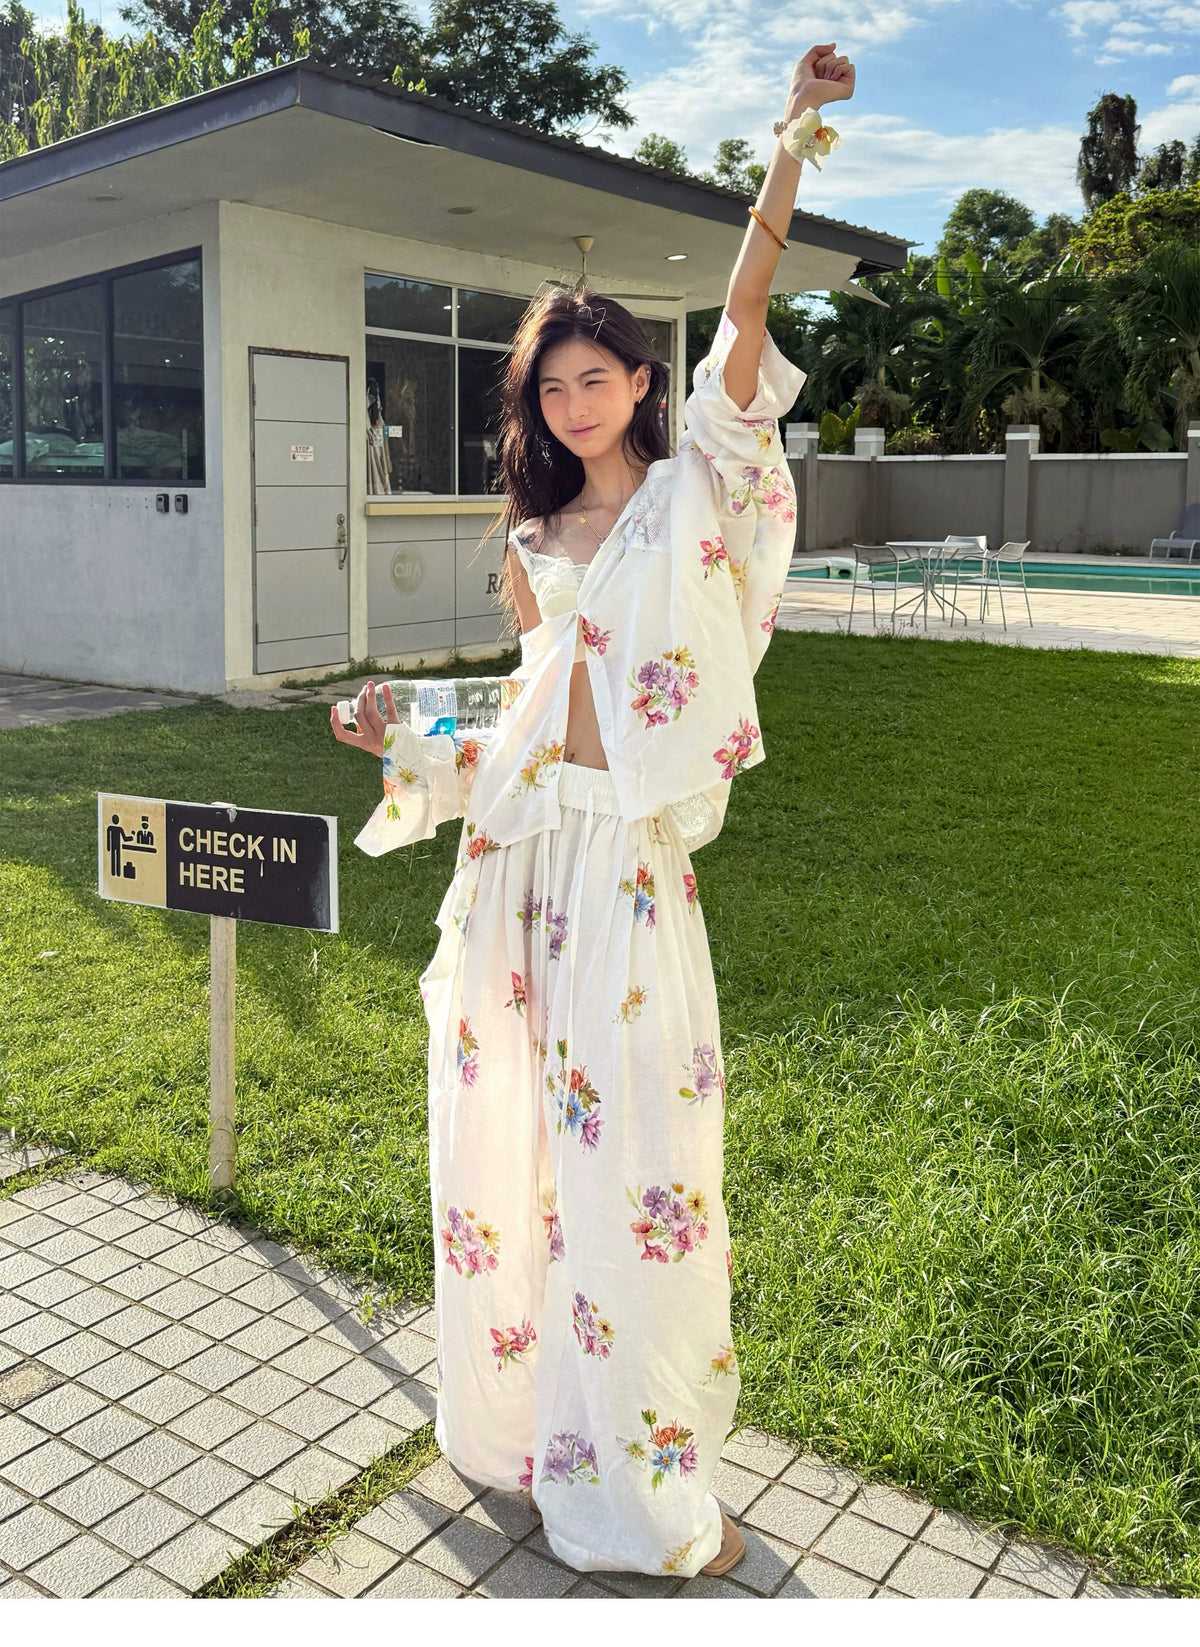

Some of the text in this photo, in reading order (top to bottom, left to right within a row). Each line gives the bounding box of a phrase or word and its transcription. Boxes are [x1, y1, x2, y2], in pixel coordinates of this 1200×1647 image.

[178, 827, 297, 864] CHECK IN
[179, 862, 245, 893] HERE
